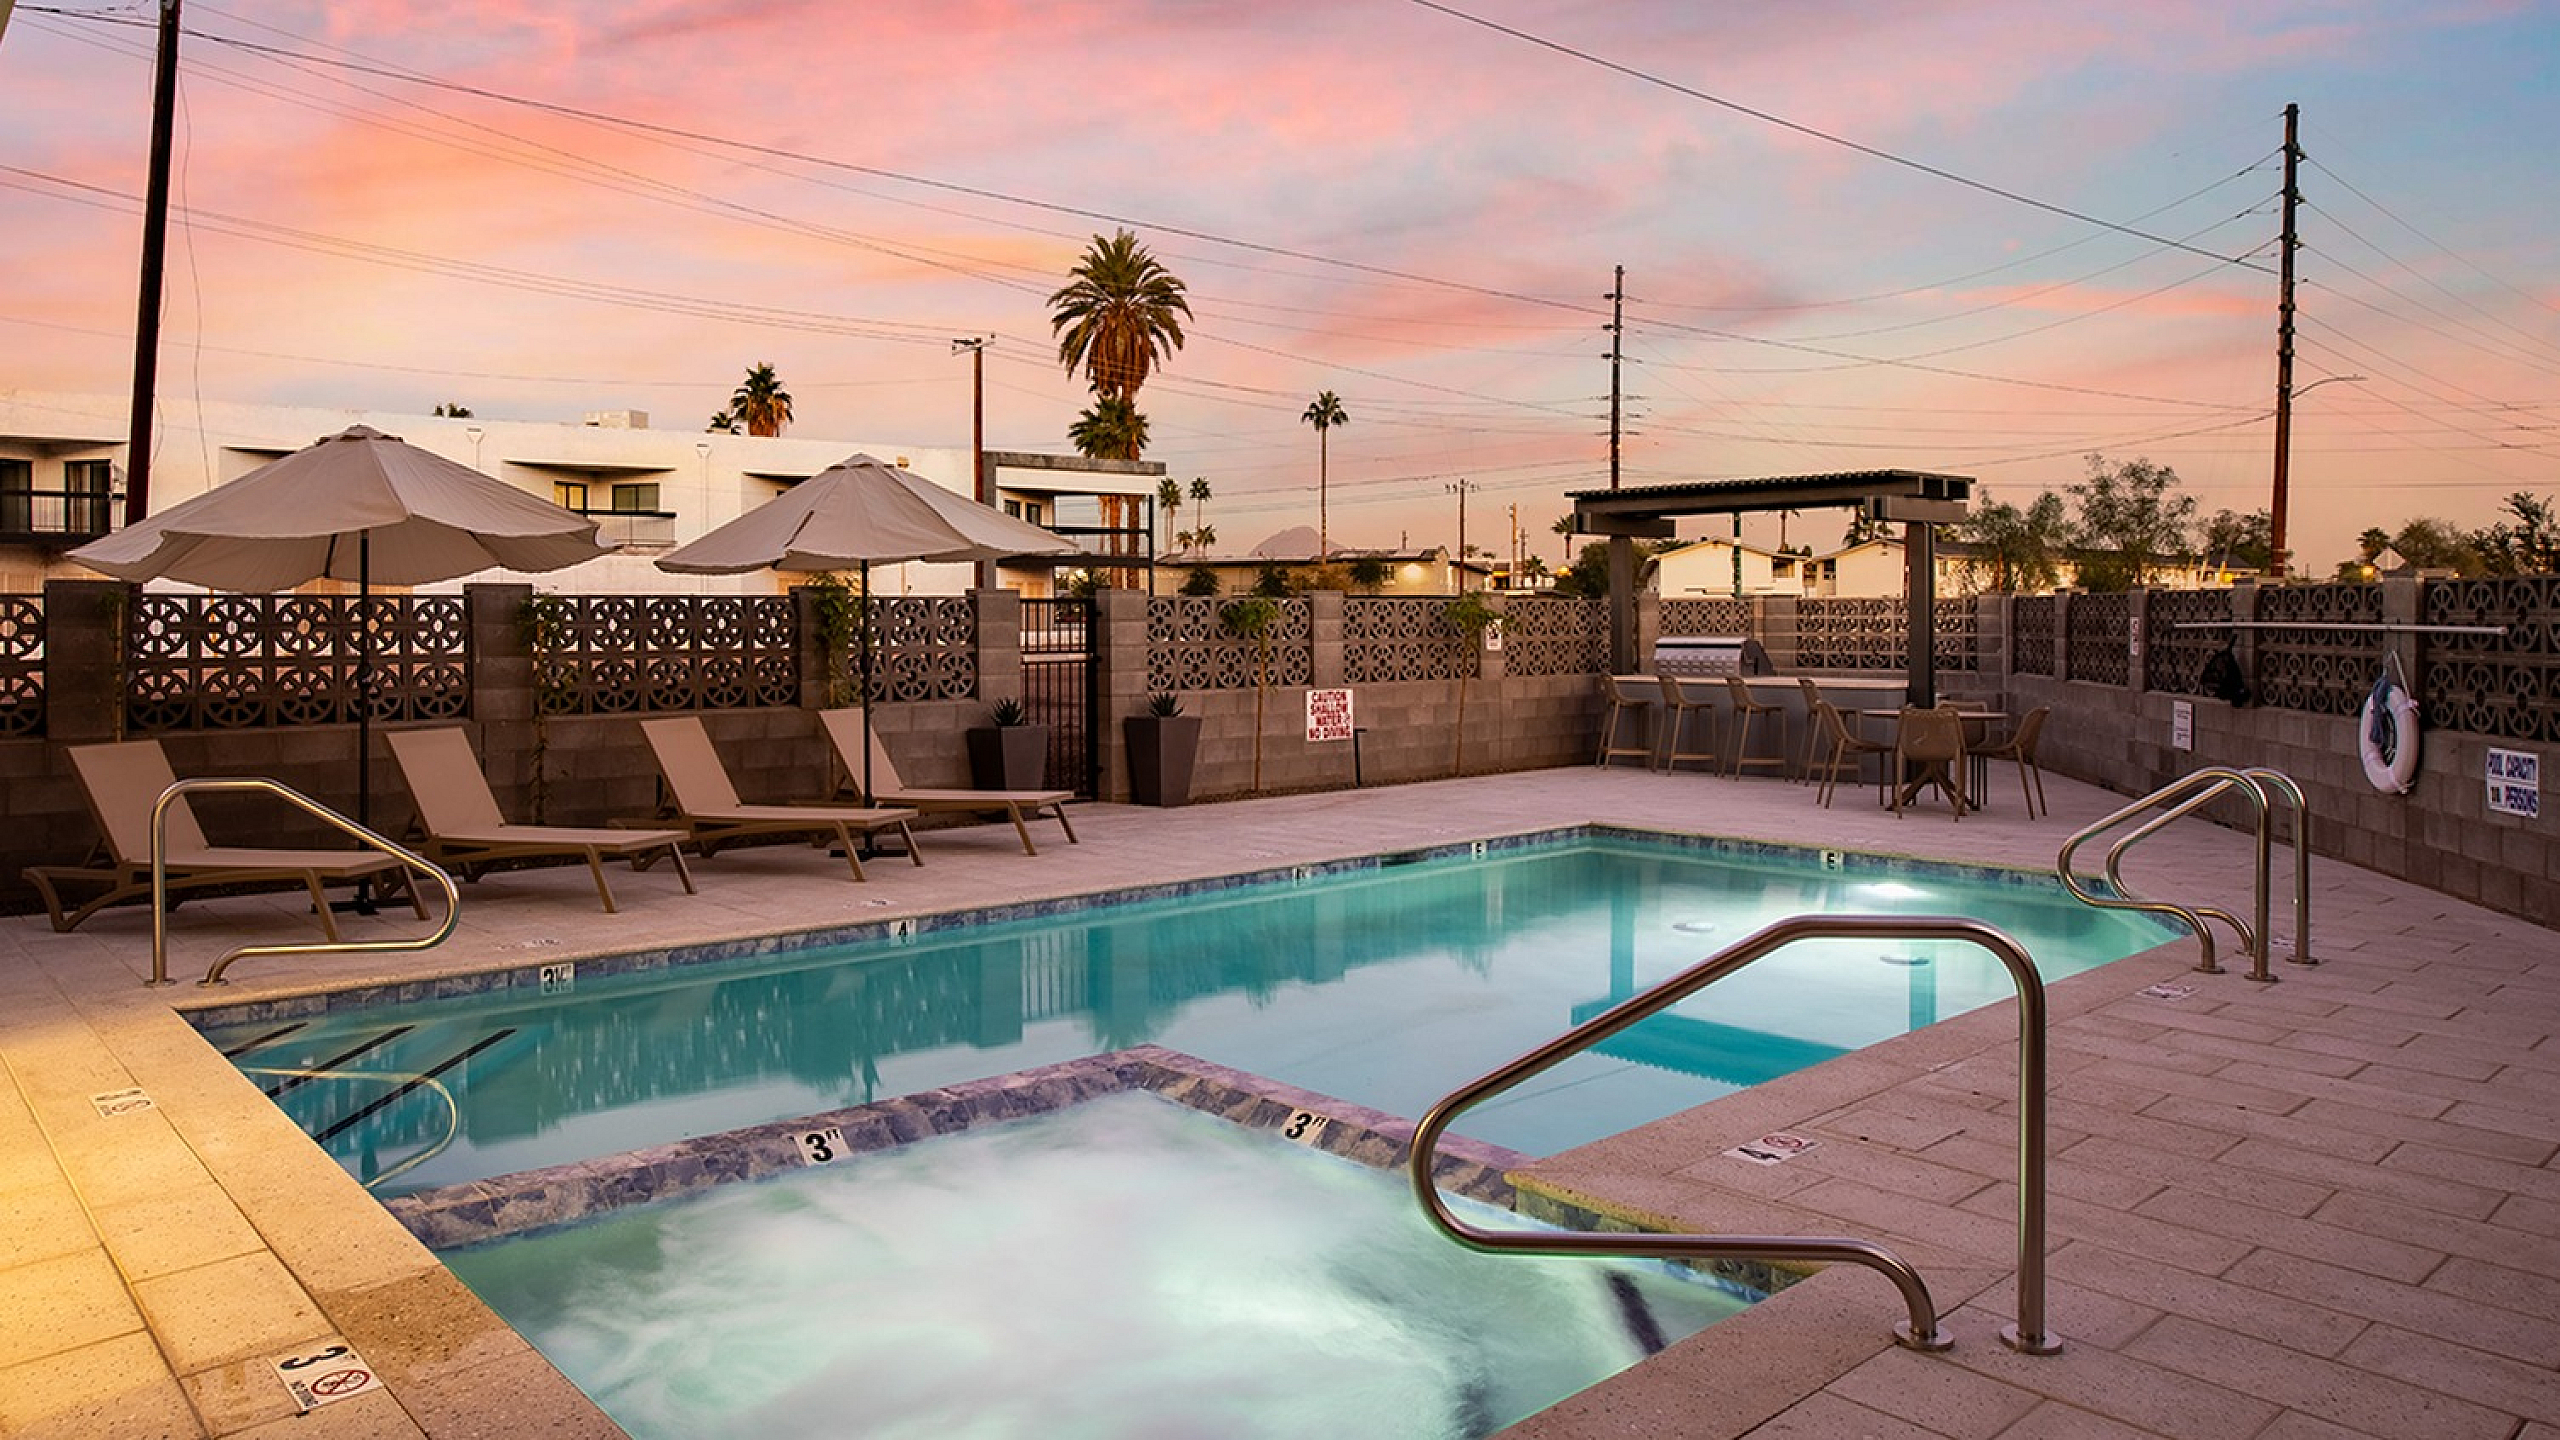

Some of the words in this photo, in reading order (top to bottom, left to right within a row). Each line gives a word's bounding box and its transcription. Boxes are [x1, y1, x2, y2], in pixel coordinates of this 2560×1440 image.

[1312, 691, 1347, 702] CAUTION
[1310, 702, 1348, 716] SHALLOW
[1315, 713, 1342, 727] WATER
[1308, 727, 1320, 739] NO
[1322, 726, 1351, 738] DIVING
[2488, 752, 2504, 777] POOL
[2506, 754, 2537, 781] CAPACITY
[2505, 785, 2537, 814] PERSONS
